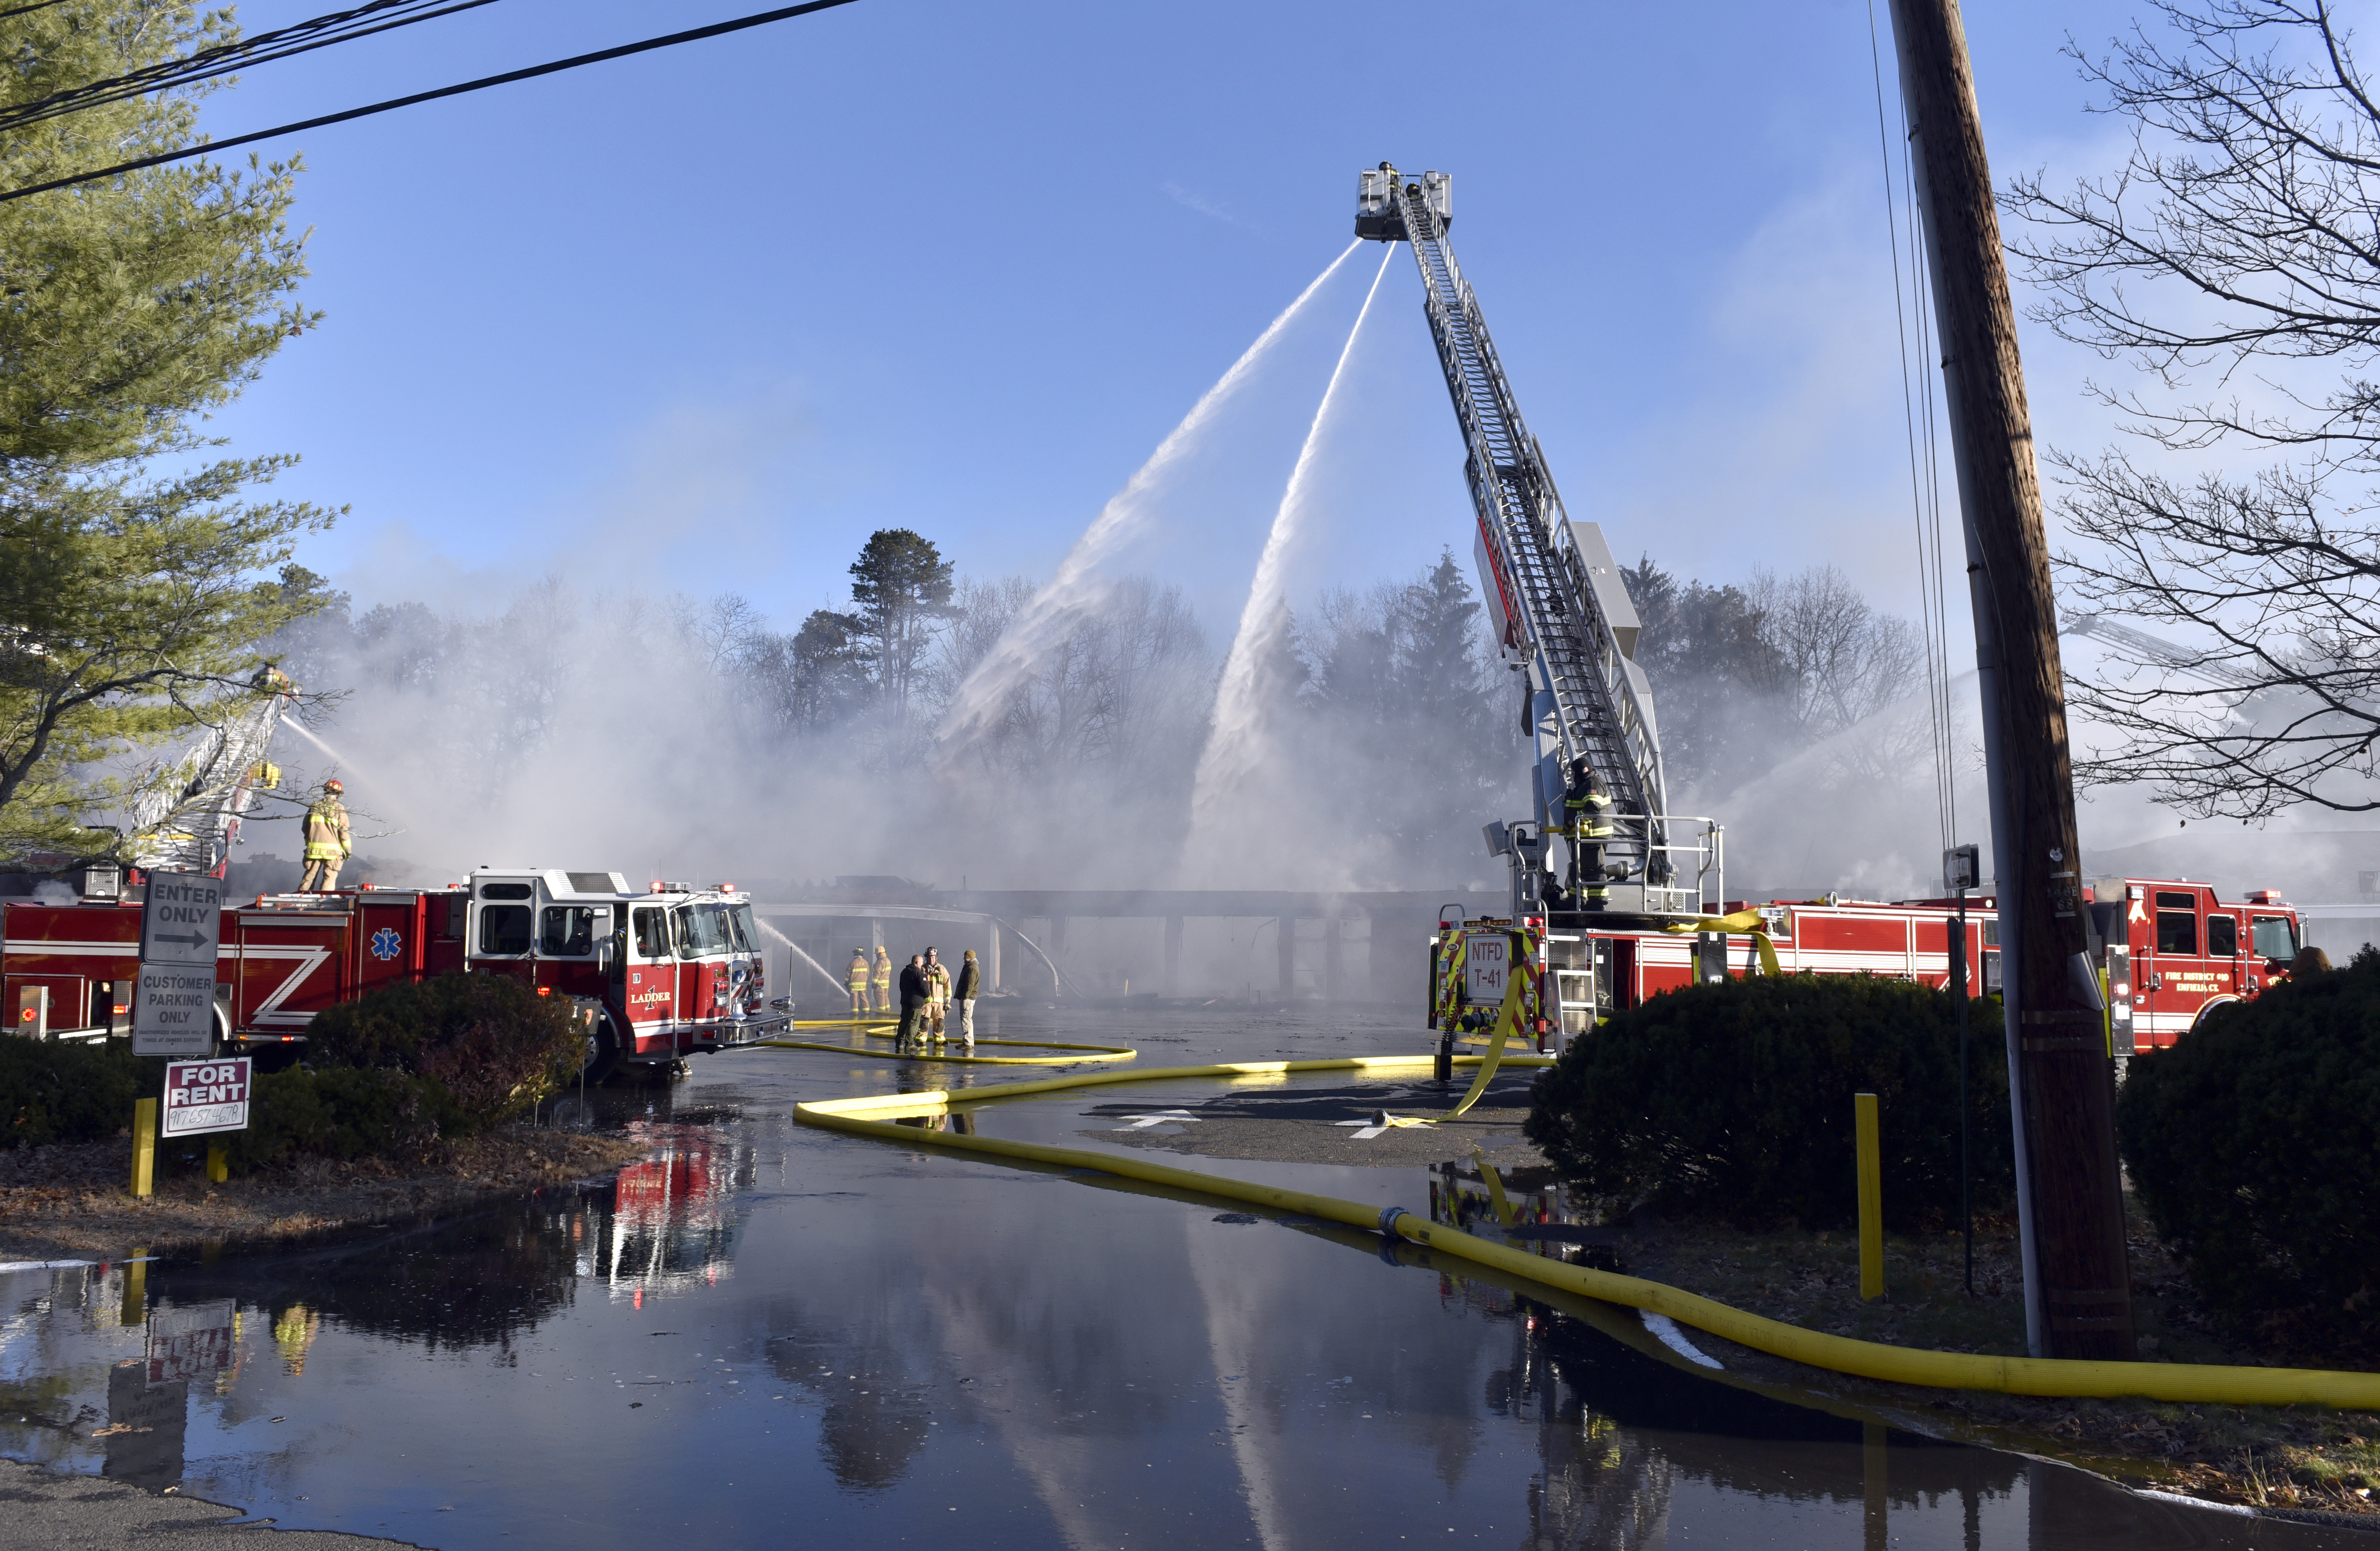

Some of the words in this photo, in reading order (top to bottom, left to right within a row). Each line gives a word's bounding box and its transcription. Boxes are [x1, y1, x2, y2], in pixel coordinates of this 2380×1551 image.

[154, 884, 217, 904] ENTER
[159, 905, 209, 924] ONLY
[1472, 942, 1503, 961] NTFD
[143, 976, 211, 990] CUSTOMER
[1474, 969, 1500, 988] T-41
[2165, 972, 2182, 980] FIRE
[2183, 972, 2215, 981] DISTRICT
[149, 994, 203, 1006] PARKING
[631, 992, 671, 1004] LADDER
[645, 985, 656, 1010] 1
[159, 1011, 191, 1023] ONLY
[182, 1065, 236, 1085] FOR
[171, 1083, 244, 1106] RENT
